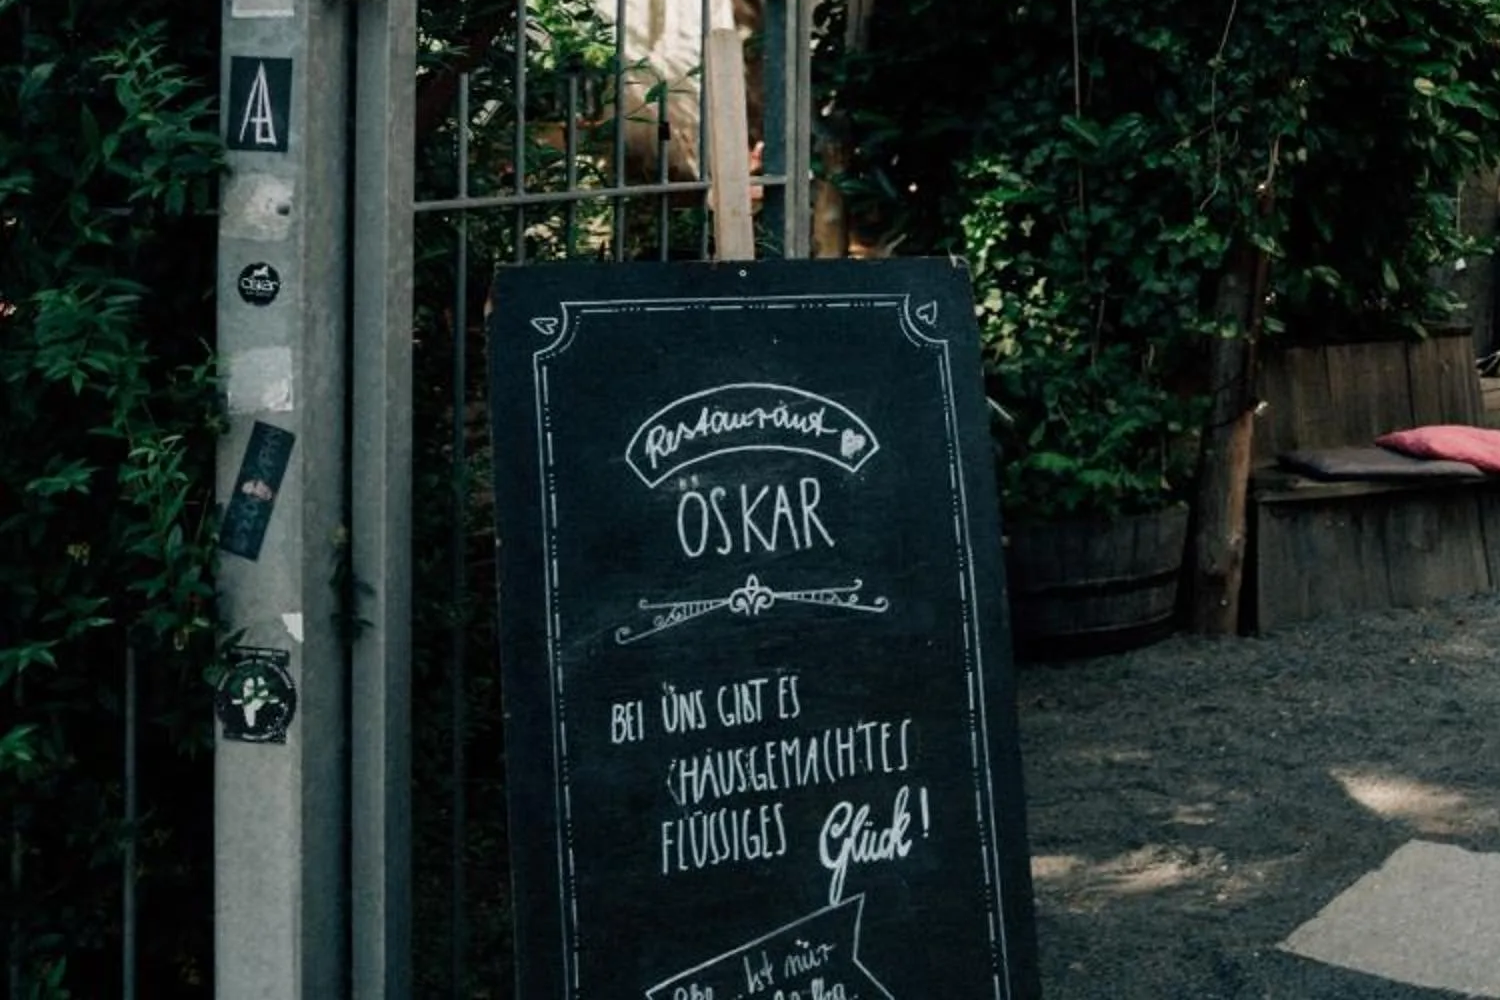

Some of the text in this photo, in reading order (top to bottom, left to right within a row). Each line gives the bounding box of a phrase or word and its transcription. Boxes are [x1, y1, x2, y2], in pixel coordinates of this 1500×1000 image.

[611, 700, 644, 744] BEI
[717, 677, 769, 728] GIBT
[777, 675, 801, 720] ES
